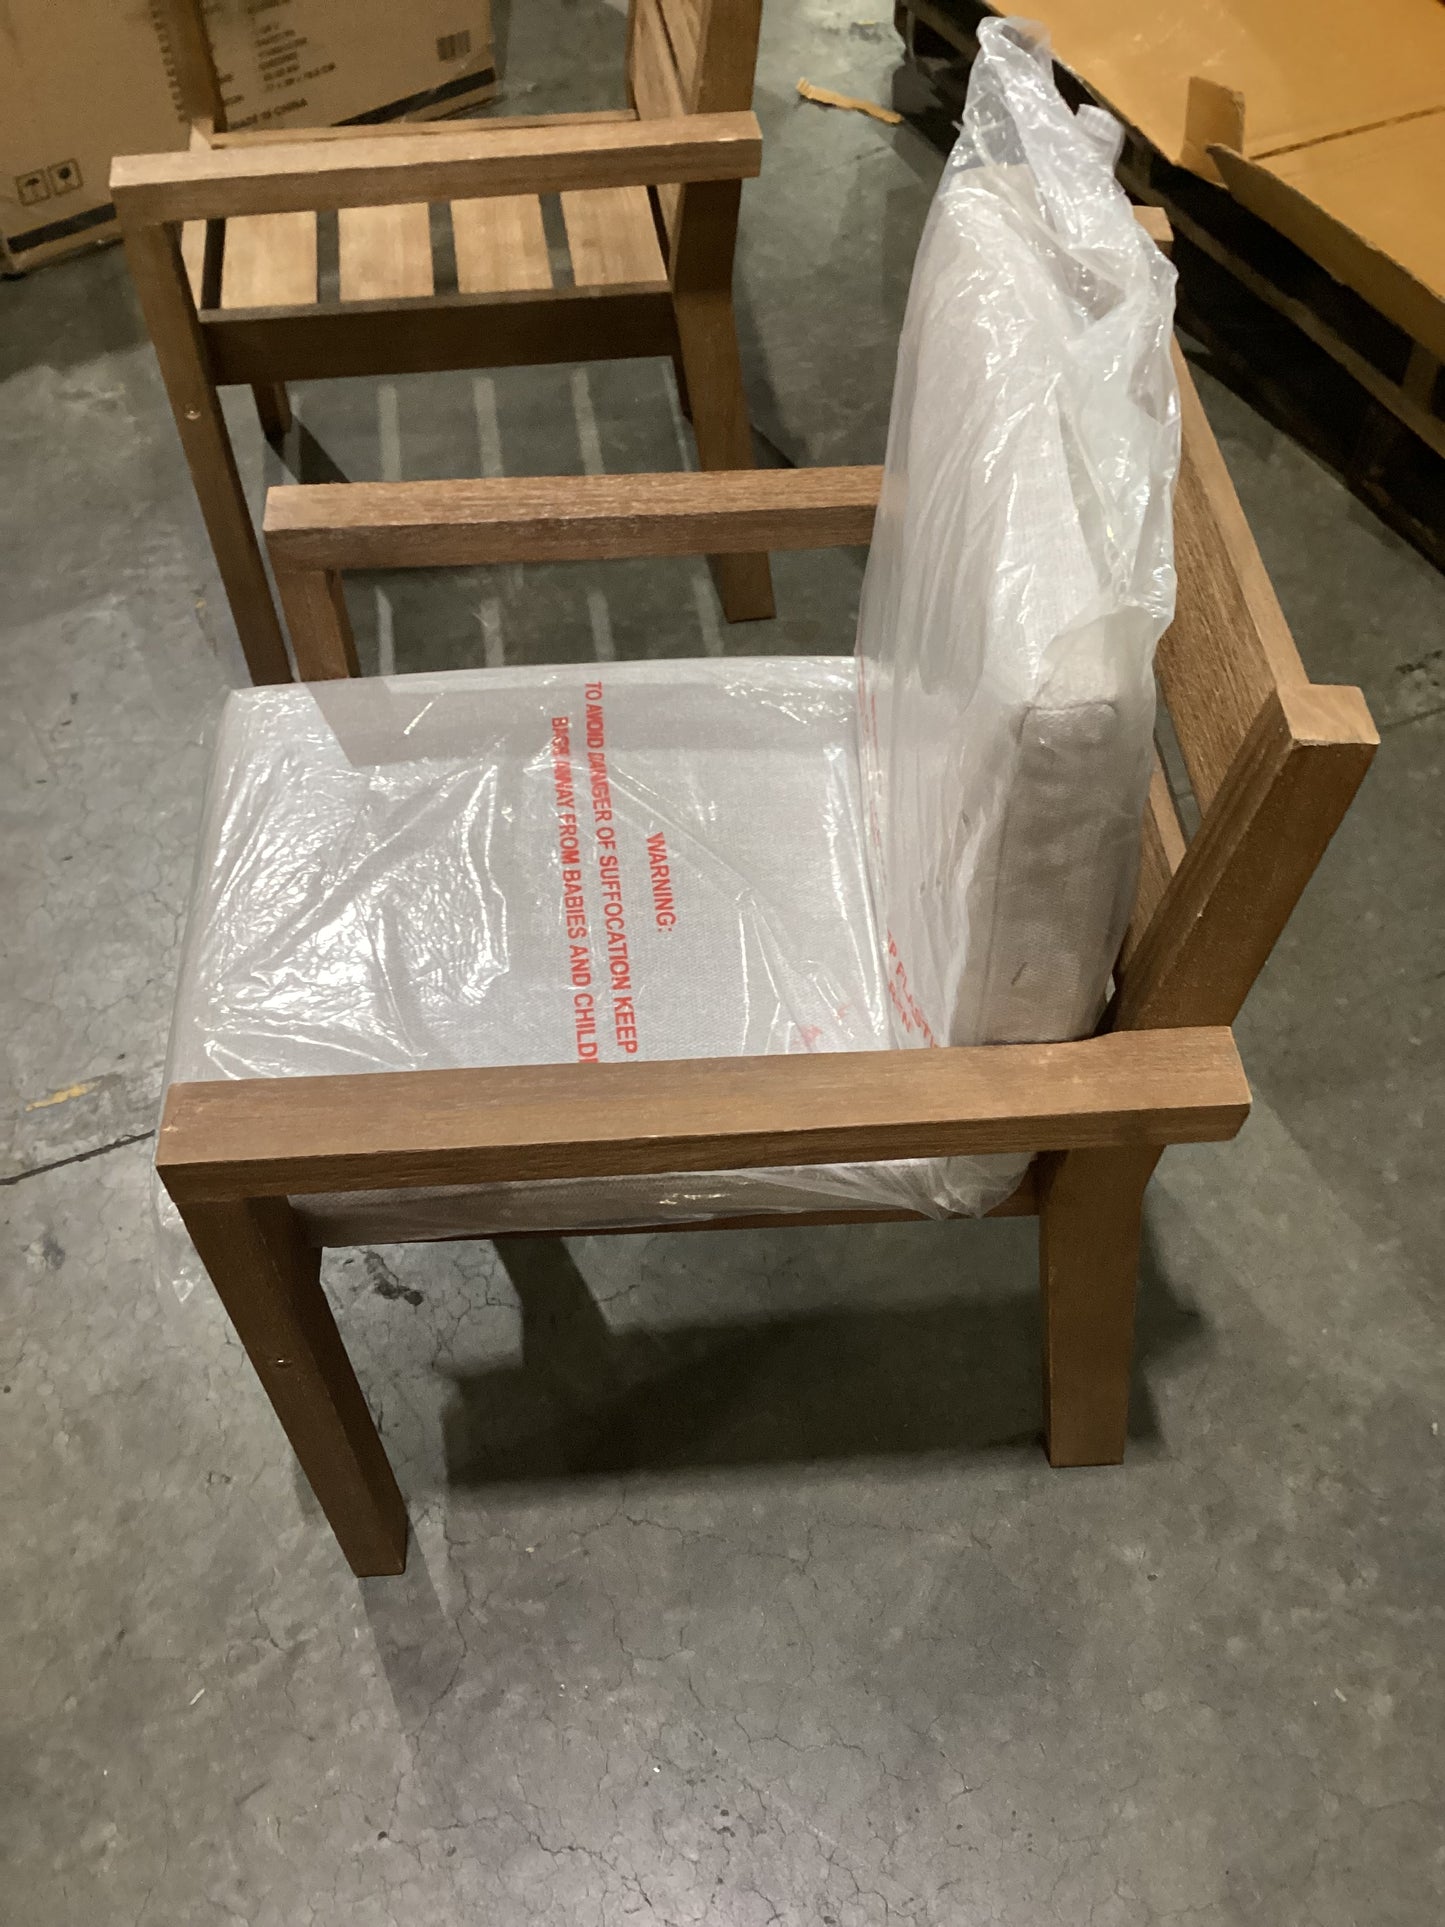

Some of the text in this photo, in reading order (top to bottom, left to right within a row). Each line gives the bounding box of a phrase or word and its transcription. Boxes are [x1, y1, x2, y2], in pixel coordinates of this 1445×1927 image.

[553, 761, 574, 807] AWAY
[559, 814, 580, 864] FROM
[585, 682, 638, 1053] TO AVOID DANGER OF SUFFOCATION KEEP
[563, 870, 587, 938] BABIES
[646, 832, 676, 932] WARNING:
[570, 945, 591, 986] AND
